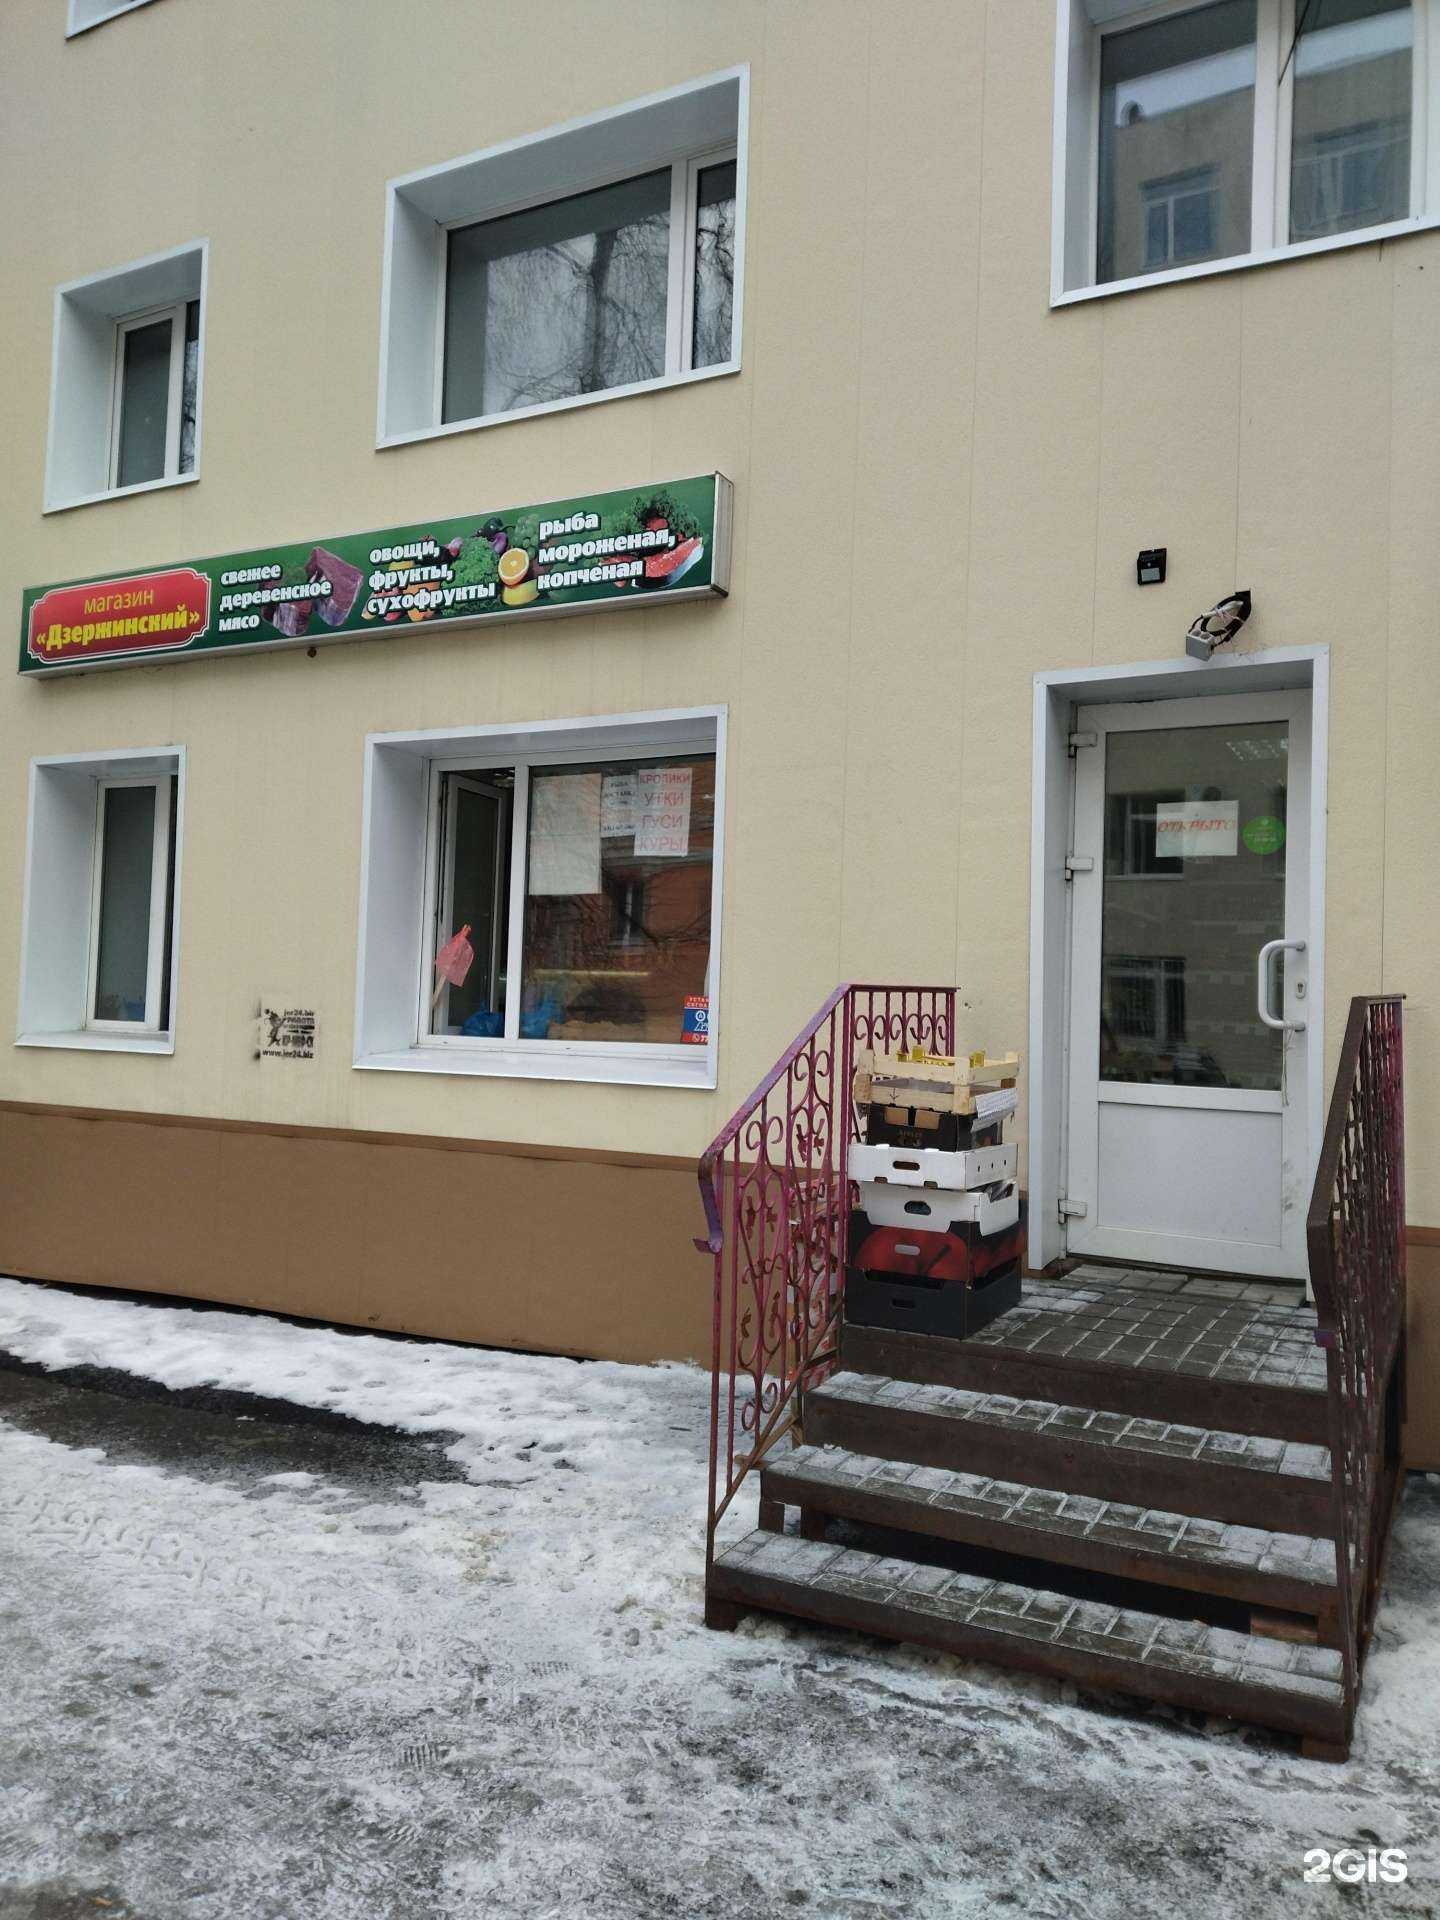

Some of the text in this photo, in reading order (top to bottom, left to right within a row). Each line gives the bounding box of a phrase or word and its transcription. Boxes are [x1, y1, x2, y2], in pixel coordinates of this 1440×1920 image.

[539, 511, 599, 540] рыба
[369, 539, 440, 564] овощи,
[538, 528, 676, 564] мороженая,
[220, 564, 282, 586] свежее
[368, 563, 453, 592] фрукты,
[537, 559, 644, 591] копченая
[84, 589, 154, 615] магазин
[219, 580, 333, 612] деревенское
[367, 582, 496, 614] сухофрукты
[36, 605, 200, 650] «Дзержинский»
[219, 614, 261, 632] мясо
[640, 773, 689, 785] КРОЛИКИ
[643, 791, 684, 807] УТКИ
[642, 814, 683, 830] ГУСИ
